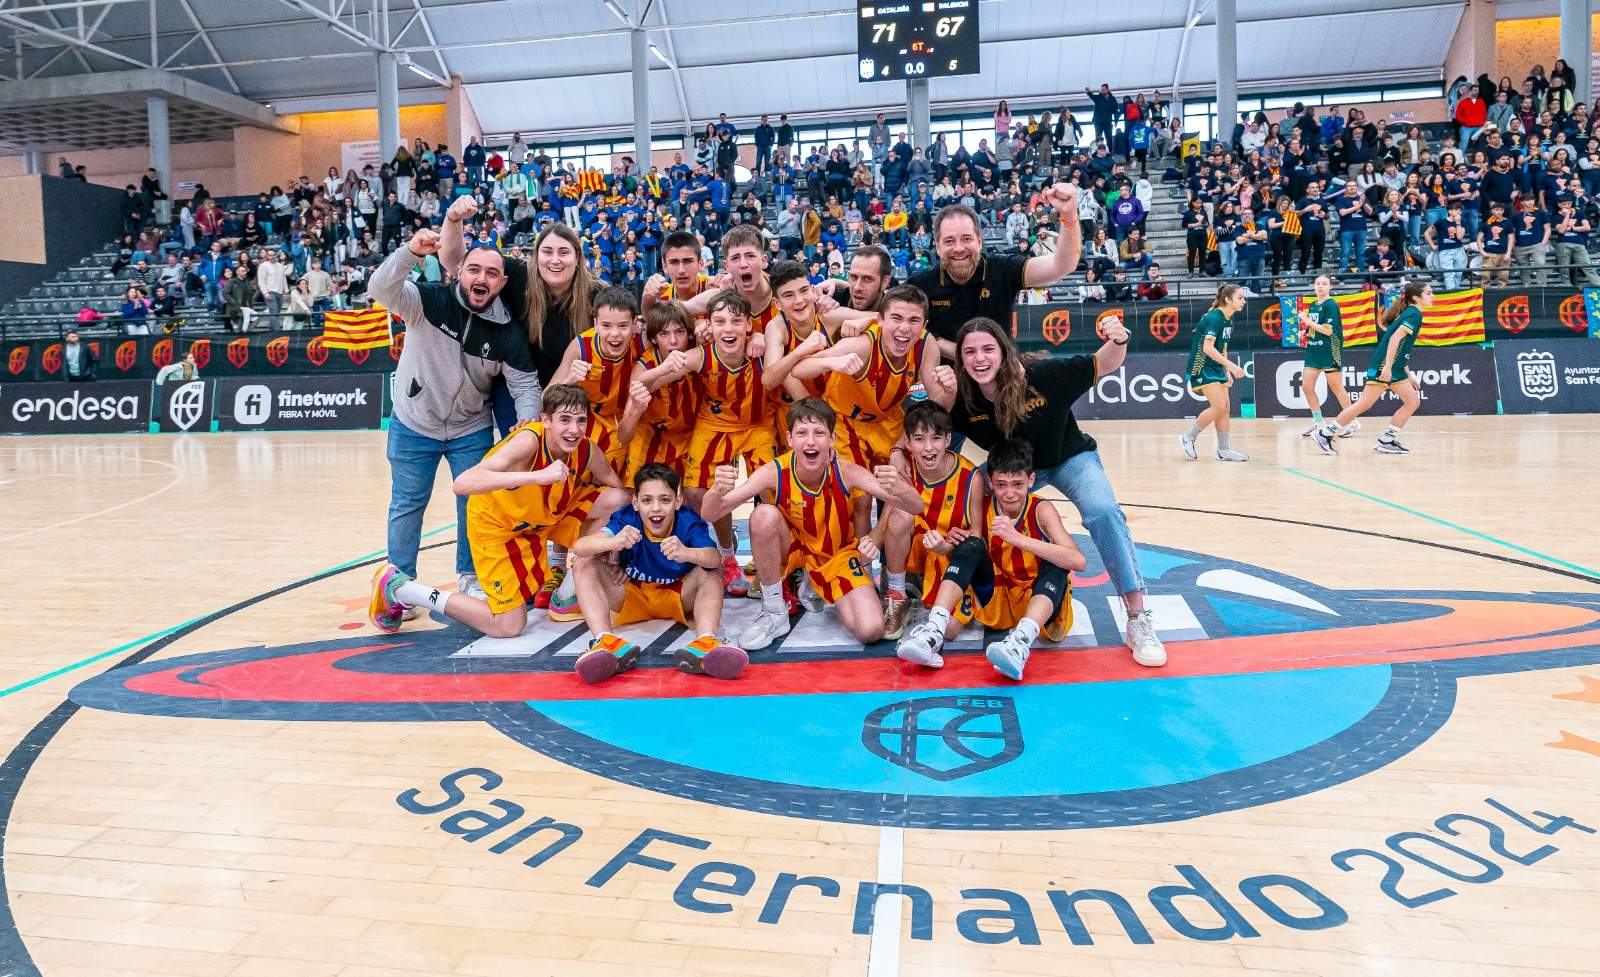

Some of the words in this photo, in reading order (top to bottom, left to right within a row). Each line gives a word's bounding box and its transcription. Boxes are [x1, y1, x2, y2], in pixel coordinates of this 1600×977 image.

[872, 23, 896, 43] 71
[936, 16, 965, 37] 67
[881, 65, 890, 76] 4
[905, 62, 925, 75] 0.0
[949, 60, 958, 70] 5
[1565, 376, 1588, 385] San
[12, 390, 138, 421] endesa
[278, 388, 367, 407] finetwork
[279, 410, 303, 419] FIBRA
[304, 410, 310, 418] Y
[312, 408, 338, 418] MÓVIL
[848, 556, 864, 577] 9
[957, 698, 1005, 708] FEB
[396, 767, 583, 868] San
[585, 828, 1349, 946] Fernando
[1331, 797, 1598, 908] 2024
